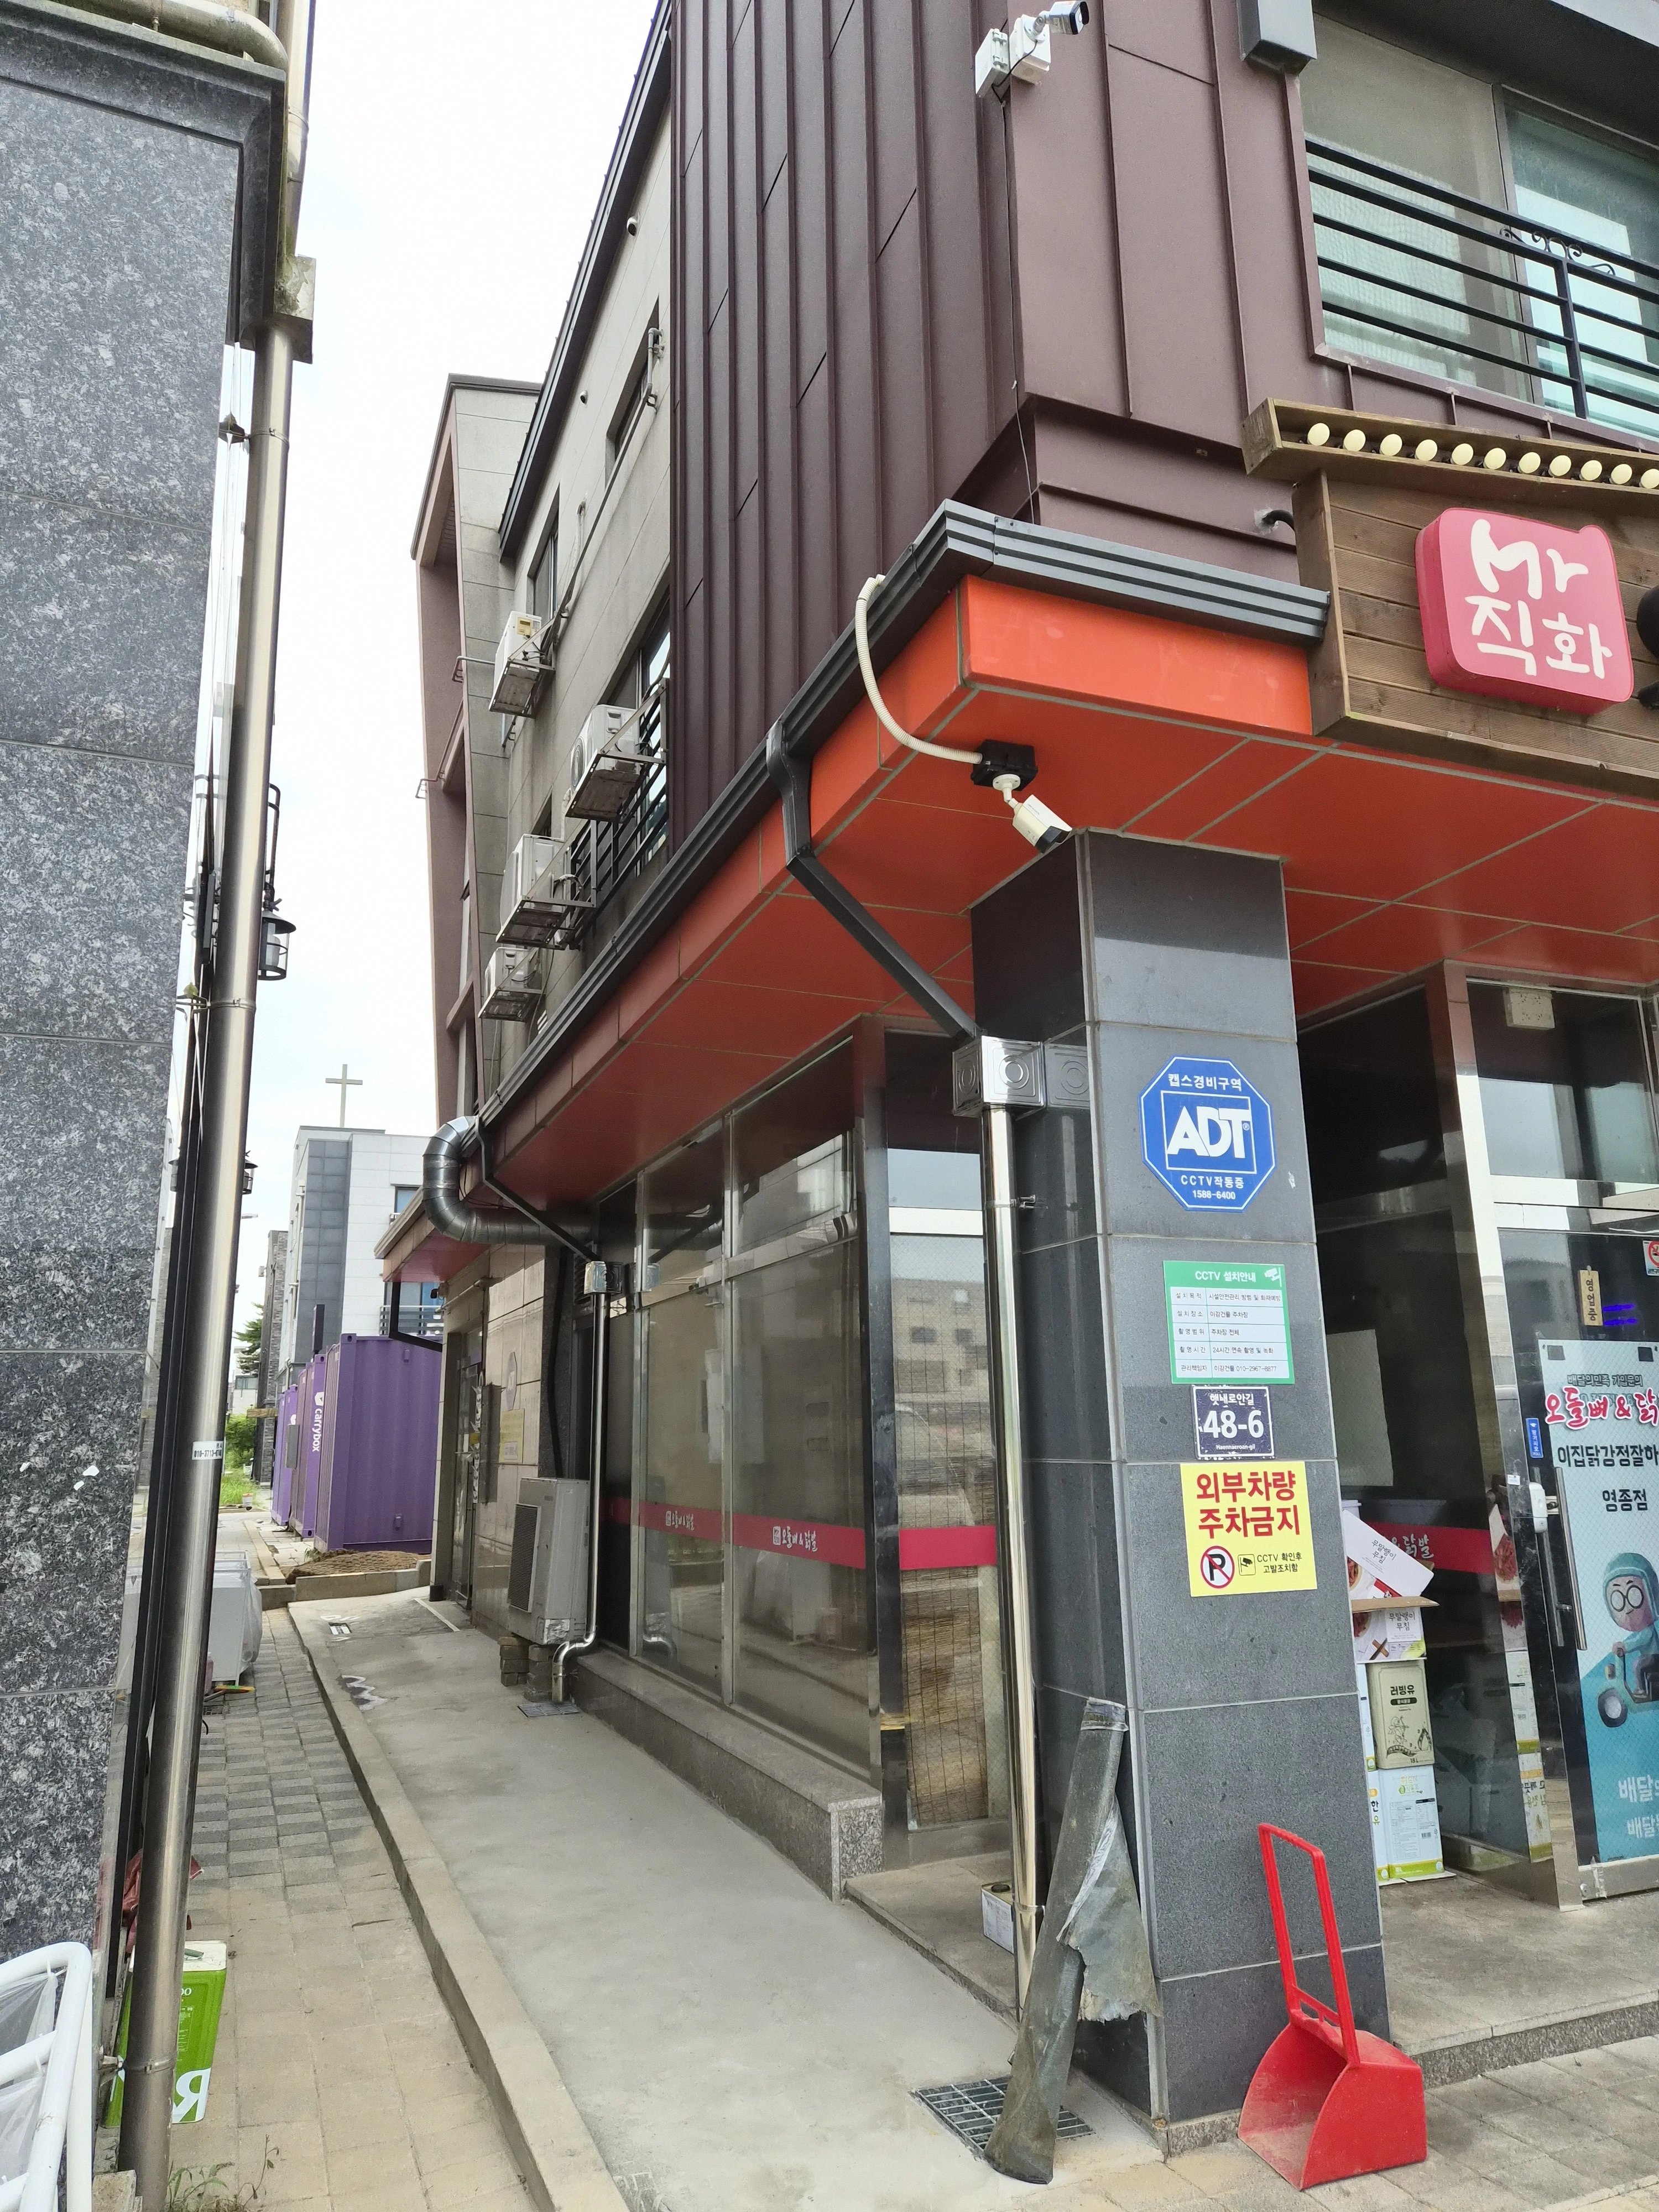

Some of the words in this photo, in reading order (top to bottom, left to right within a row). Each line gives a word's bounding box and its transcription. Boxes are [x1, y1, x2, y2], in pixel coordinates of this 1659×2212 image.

[1470, 519, 1589, 599] Mr
[1465, 595, 1613, 679] 직화
[1168, 1073, 1242, 1092] 캡스경비구역
[1167, 1105, 1251, 1158] ADT
[1192, 1190, 1236, 1200] 1588-6400
[1195, 1271, 1220, 1281] CCTV
[1223, 1272, 1256, 1282] 설치안내
[1567, 1374, 1610, 1387] 배달의민족
[1612, 1374, 1644, 1387] 가입문의
[1209, 1393, 1255, 1406] 햇내로안길
[312, 1408, 322, 1452] carrybox
[1203, 1410, 1264, 1438] 48-6
[1196, 1470, 1296, 1503] 외부차량
[1602, 1489, 1648, 1512] 영종점
[1198, 1505, 1300, 1539] 주차금지
[1256, 1554, 1279, 1563] CCTV
[1281, 1552, 1302, 1562] 확인후
[1263, 1563, 1298, 1574] 고발조치함
[1390, 1684, 1415, 1696] 러빙유
